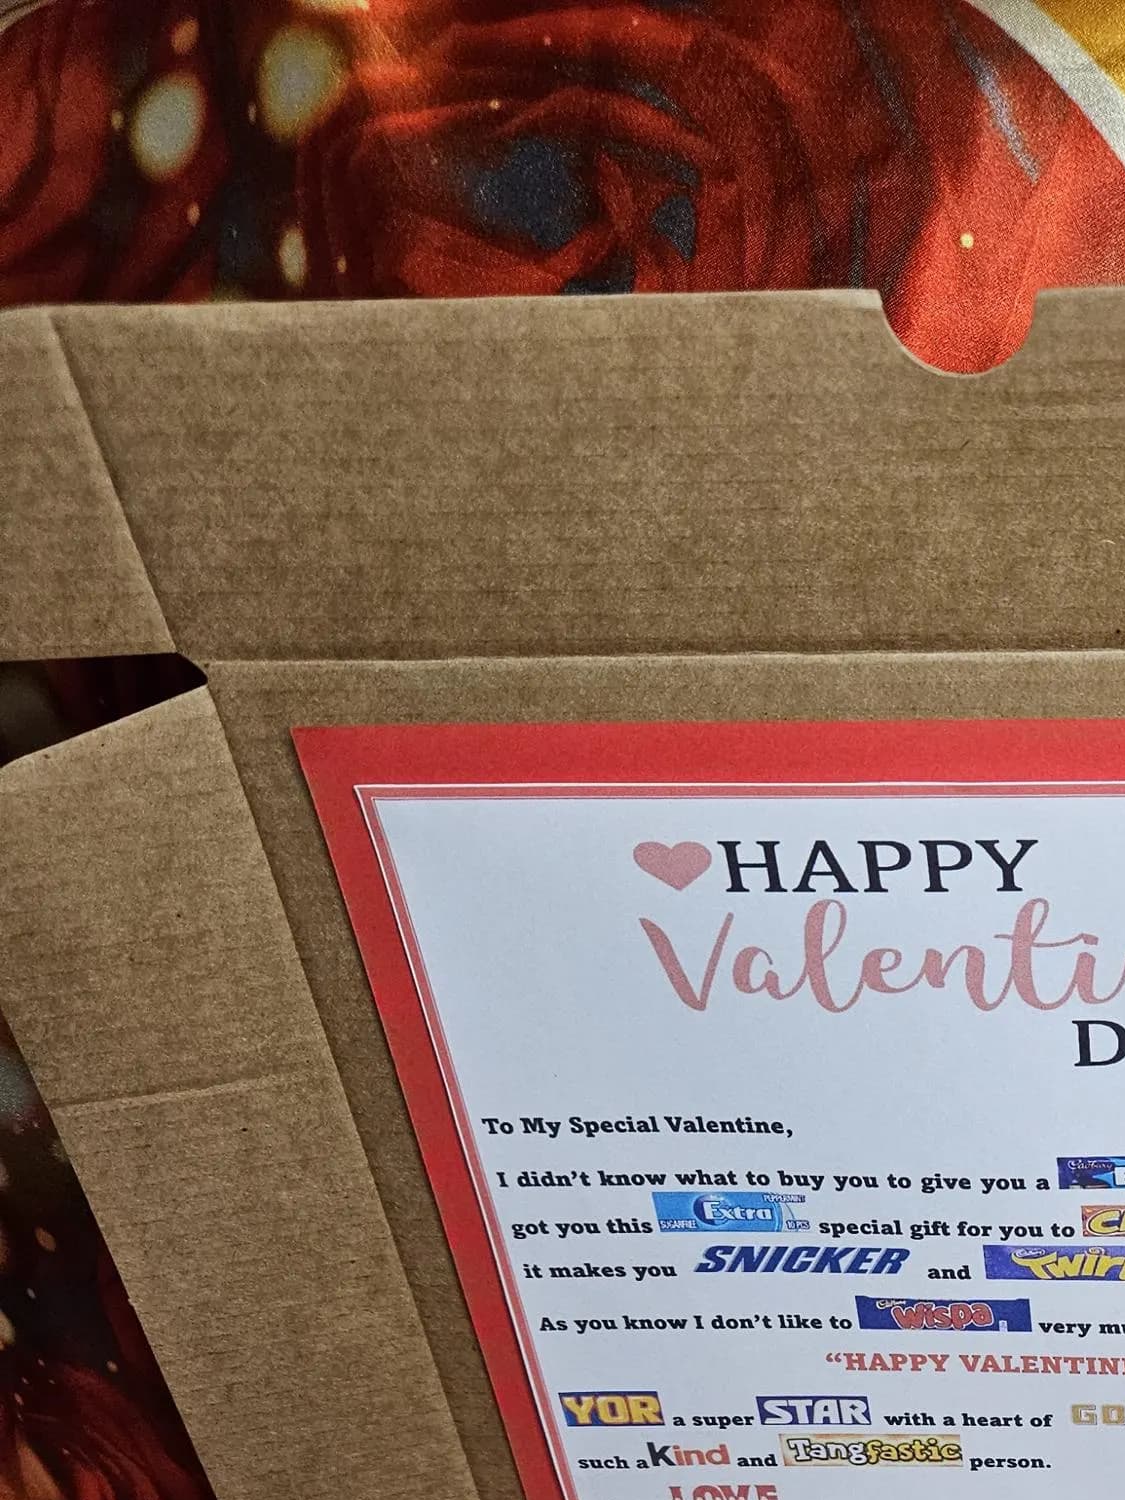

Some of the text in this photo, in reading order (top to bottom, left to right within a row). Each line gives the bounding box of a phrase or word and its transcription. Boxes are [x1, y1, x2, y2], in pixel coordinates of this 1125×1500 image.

[717, 840, 1038, 893] HAPPY
[480, 1115, 794, 1139] To My Special Valentine,
[495, 1171, 510, 1188] I
[516, 1170, 592, 1188] didn't
[596, 1169, 667, 1187] know
[673, 1168, 739, 1186] what
[744, 1170, 771, 1187] to
[776, 1169, 825, 1192] buy
[832, 1175, 880, 1193] you
[886, 1173, 912, 1190] to
[920, 1172, 972, 1194] give
[979, 1177, 1028, 1195] you
[1035, 1177, 1051, 1191] a
[510, 1219, 551, 1240] got
[554, 1222, 602, 1240] you
[605, 1217, 654, 1235] this
[703, 1200, 773, 1221] Extra
[818, 1218, 904, 1239] special
[909, 1219, 951, 1241] gift
[956, 1220, 993, 1237] for
[998, 1225, 1045, 1242] you
[1049, 1222, 1076, 1238] to
[522, 1263, 544, 1279] it
[548, 1262, 628, 1279] makes
[631, 1265, 678, 1282] you
[694, 1245, 911, 1276] SNICKER
[927, 1264, 973, 1281] and
[539, 1316, 569, 1332] As
[573, 1319, 619, 1335] you
[621, 1314, 689, 1331] know
[692, 1314, 705, 1330] I
[710, 1313, 773, 1330] don't
[776, 1313, 823, 1330] like
[828, 1315, 853, 1330] to
[891, 1302, 994, 1330] Wispa
[1037, 1322, 1093, 1339] very
[562, 1394, 661, 1425] YOR
[672, 1416, 687, 1427] a
[691, 1415, 755, 1430] super
[762, 1398, 871, 1425] STAR
[883, 1411, 937, 1427] with
[942, 1415, 957, 1427] a
[960, 1412, 1024, 1428] heart
[1029, 1413, 1054, 1428] of
[577, 1438, 1052, 1472] such a Kind and Tangfastic person.
